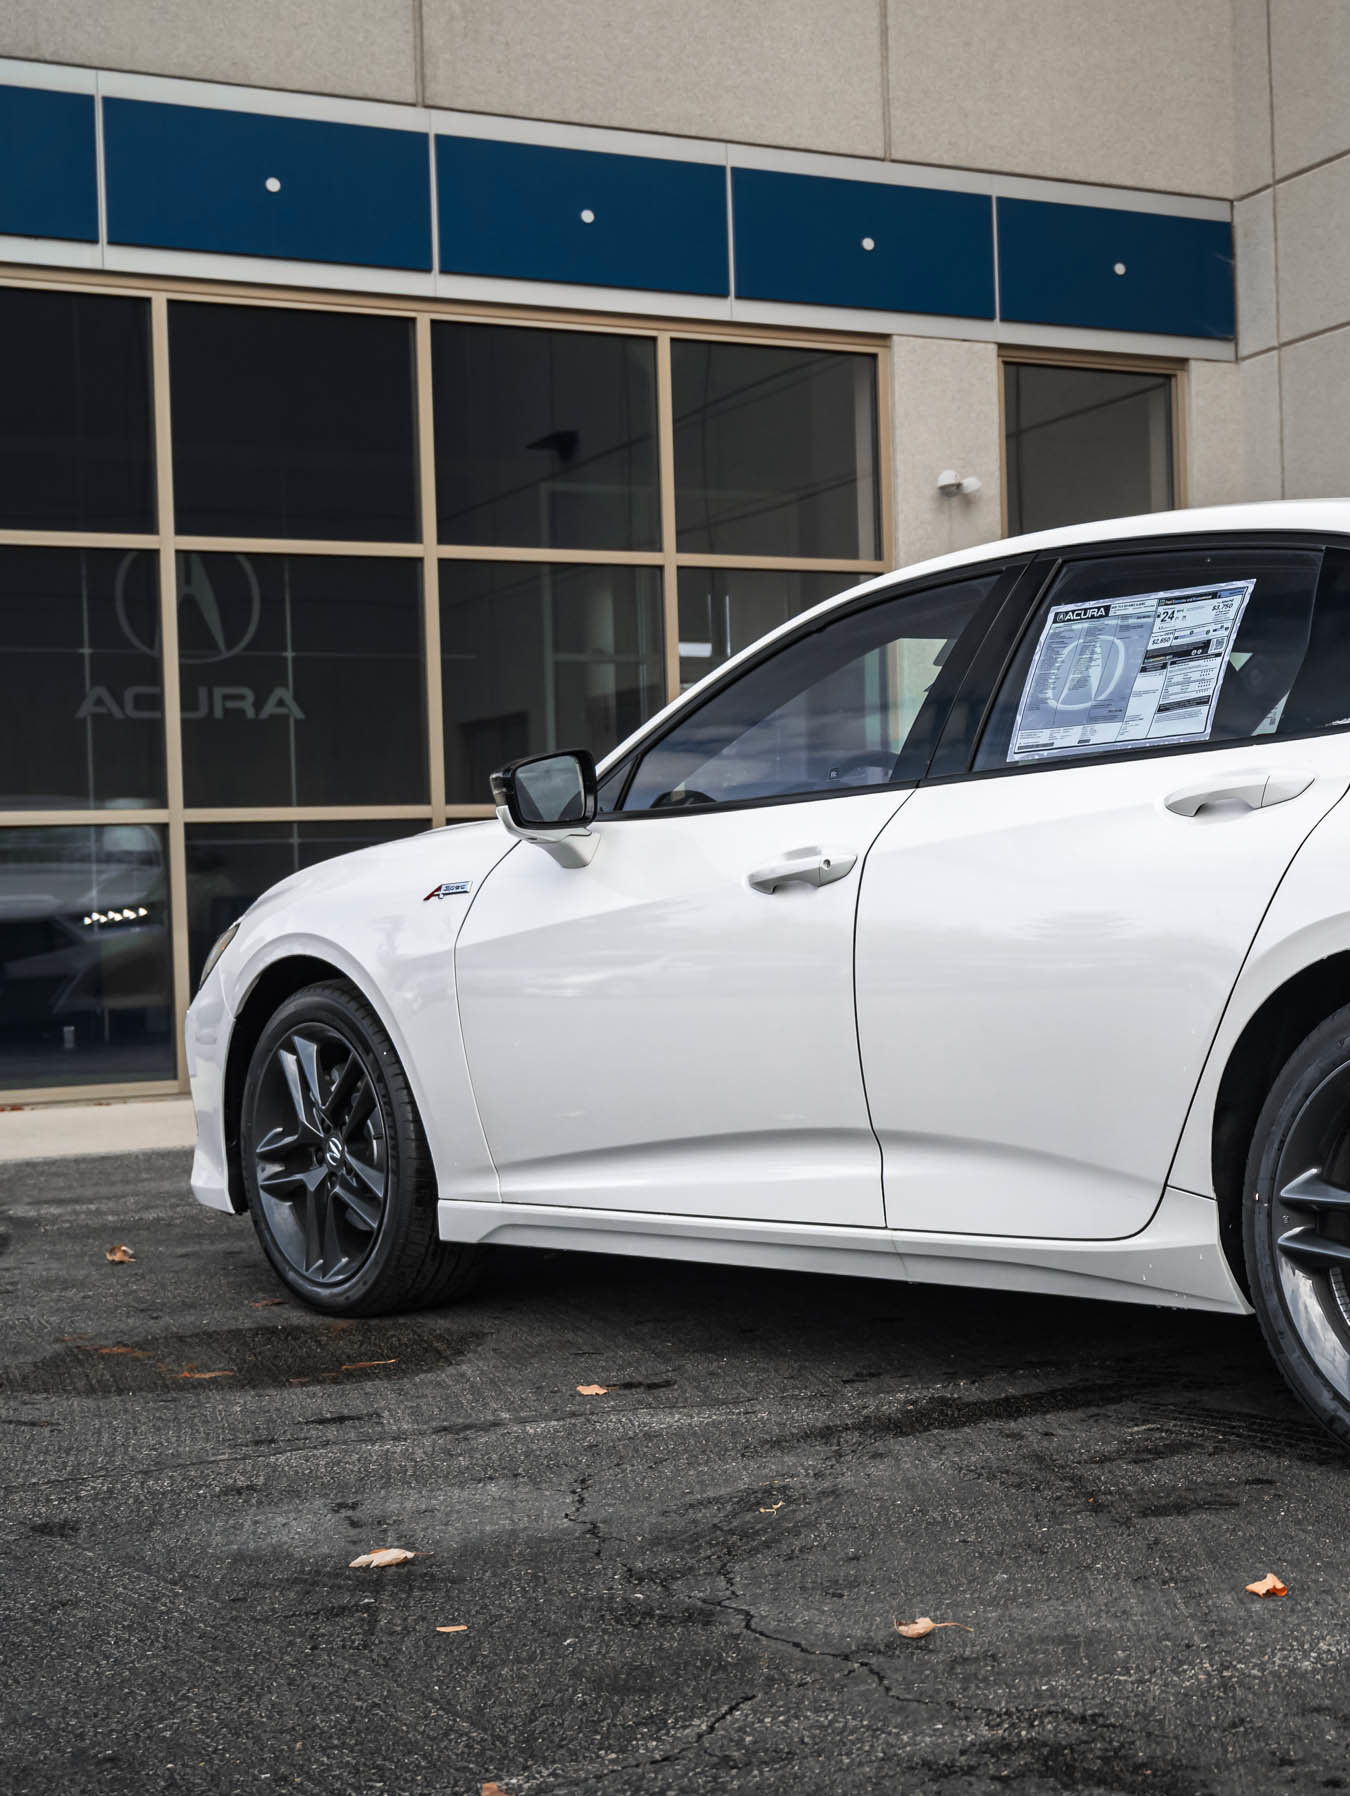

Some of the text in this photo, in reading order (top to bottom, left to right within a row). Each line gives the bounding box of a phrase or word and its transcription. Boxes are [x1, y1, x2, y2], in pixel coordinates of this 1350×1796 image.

[1065, 608, 1105, 621] ACURA
[1161, 610, 1175, 622] 24
[75, 686, 305, 719] ACURA
